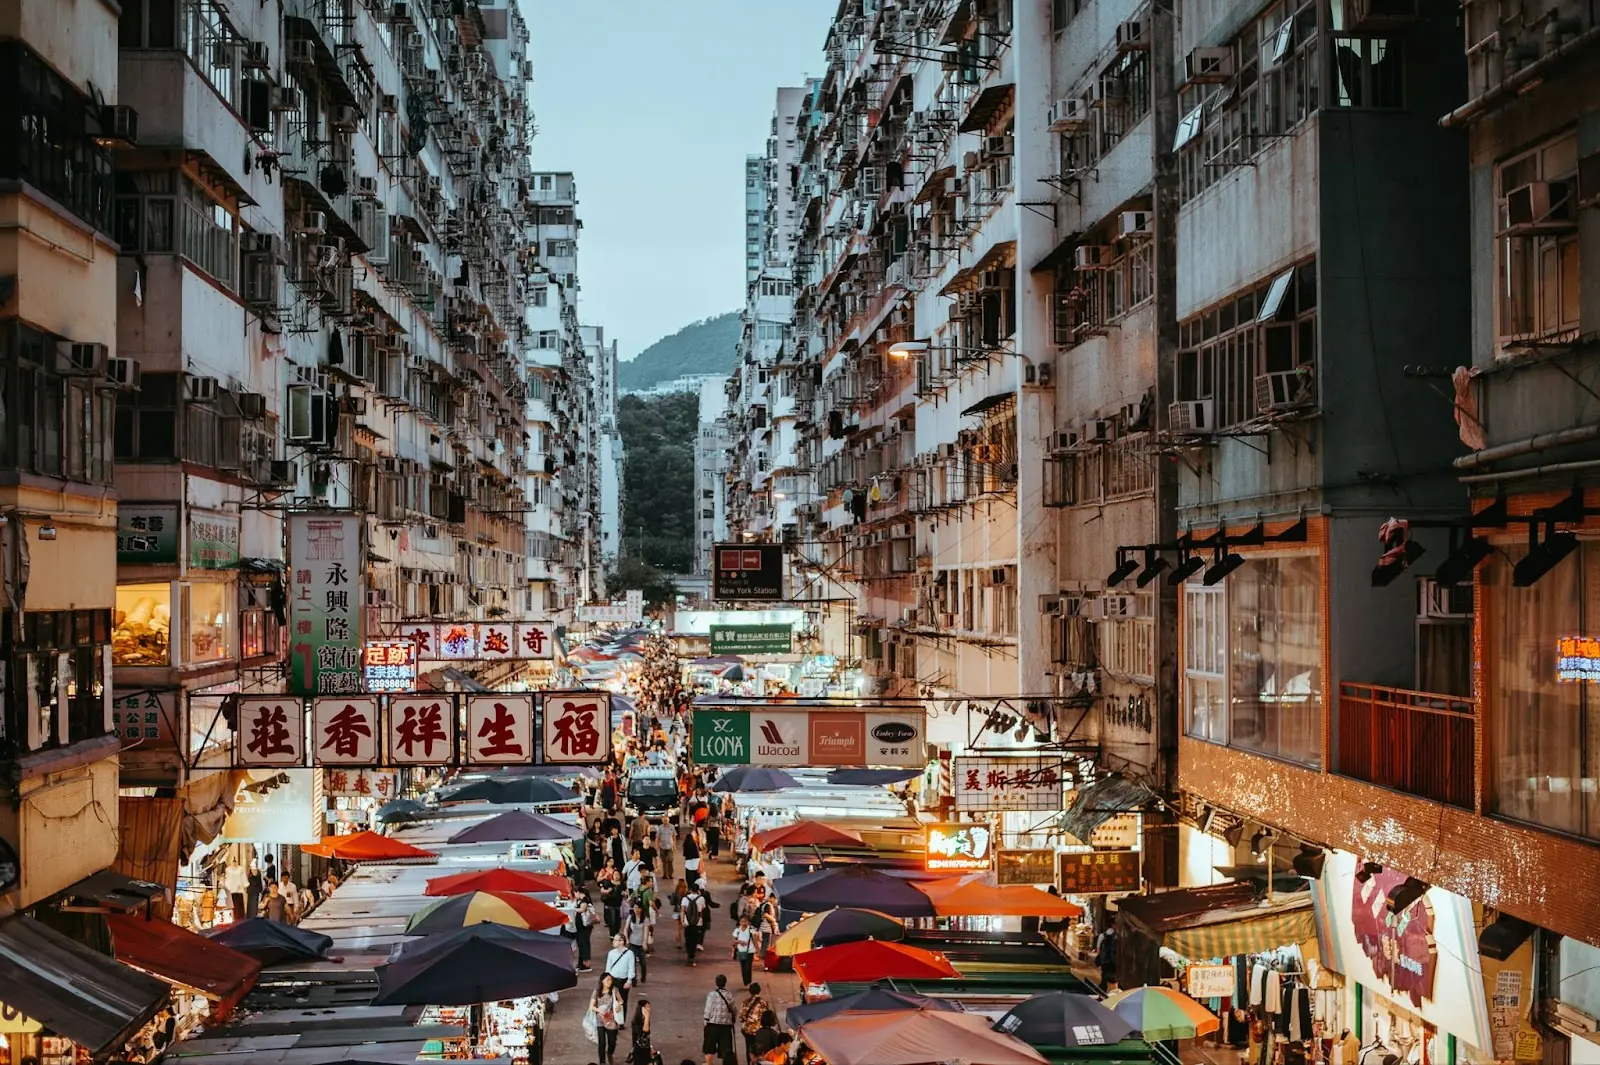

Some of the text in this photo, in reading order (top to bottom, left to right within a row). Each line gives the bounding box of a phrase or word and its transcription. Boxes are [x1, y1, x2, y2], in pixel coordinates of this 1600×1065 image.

[297, 569, 312, 635] 請上一樓
[325, 562, 349, 641] 永興隆
[701, 735, 744, 757] LEONA
[758, 746, 800, 756] Wacoal
[819, 734, 855, 747] Triumph
